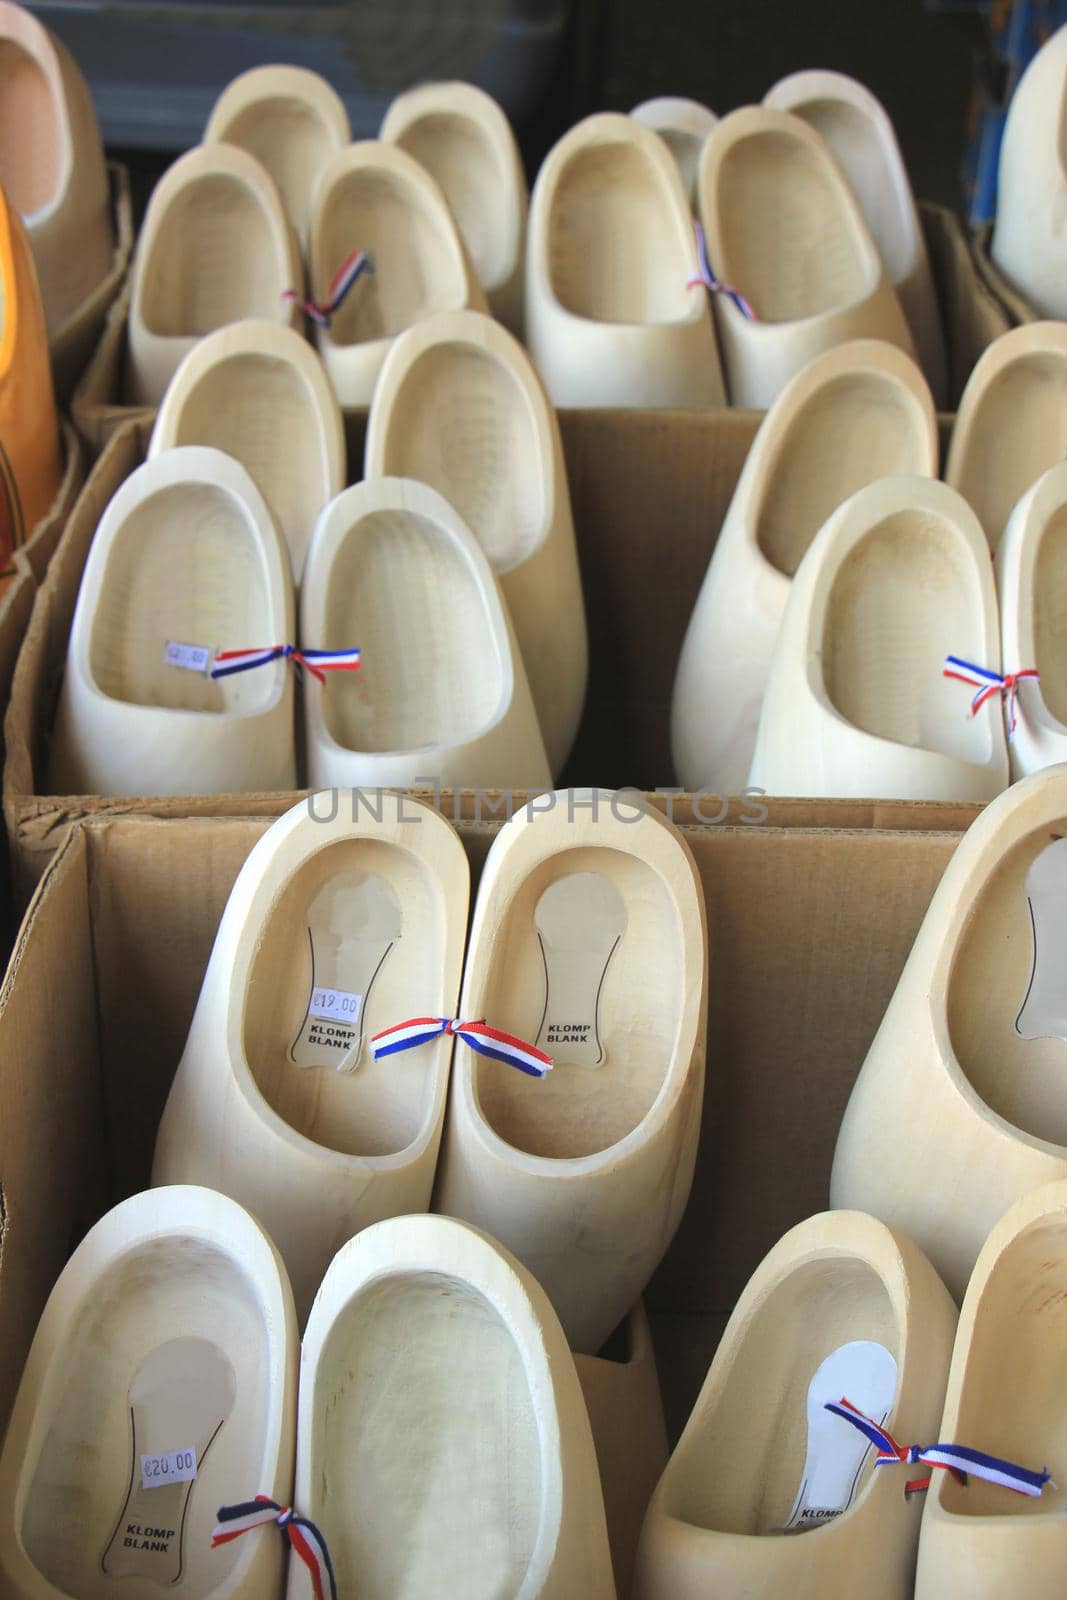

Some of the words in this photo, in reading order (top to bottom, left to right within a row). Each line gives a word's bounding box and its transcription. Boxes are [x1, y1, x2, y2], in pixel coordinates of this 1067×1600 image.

[313, 993, 357, 1013] €19.00
[311, 1024, 356, 1039] KLOMP
[308, 1035, 351, 1049] BLANK
[144, 1453, 193, 1477] €20.00
[127, 1524, 175, 1539] KLOMP
[123, 1537, 169, 1552] BLANK
